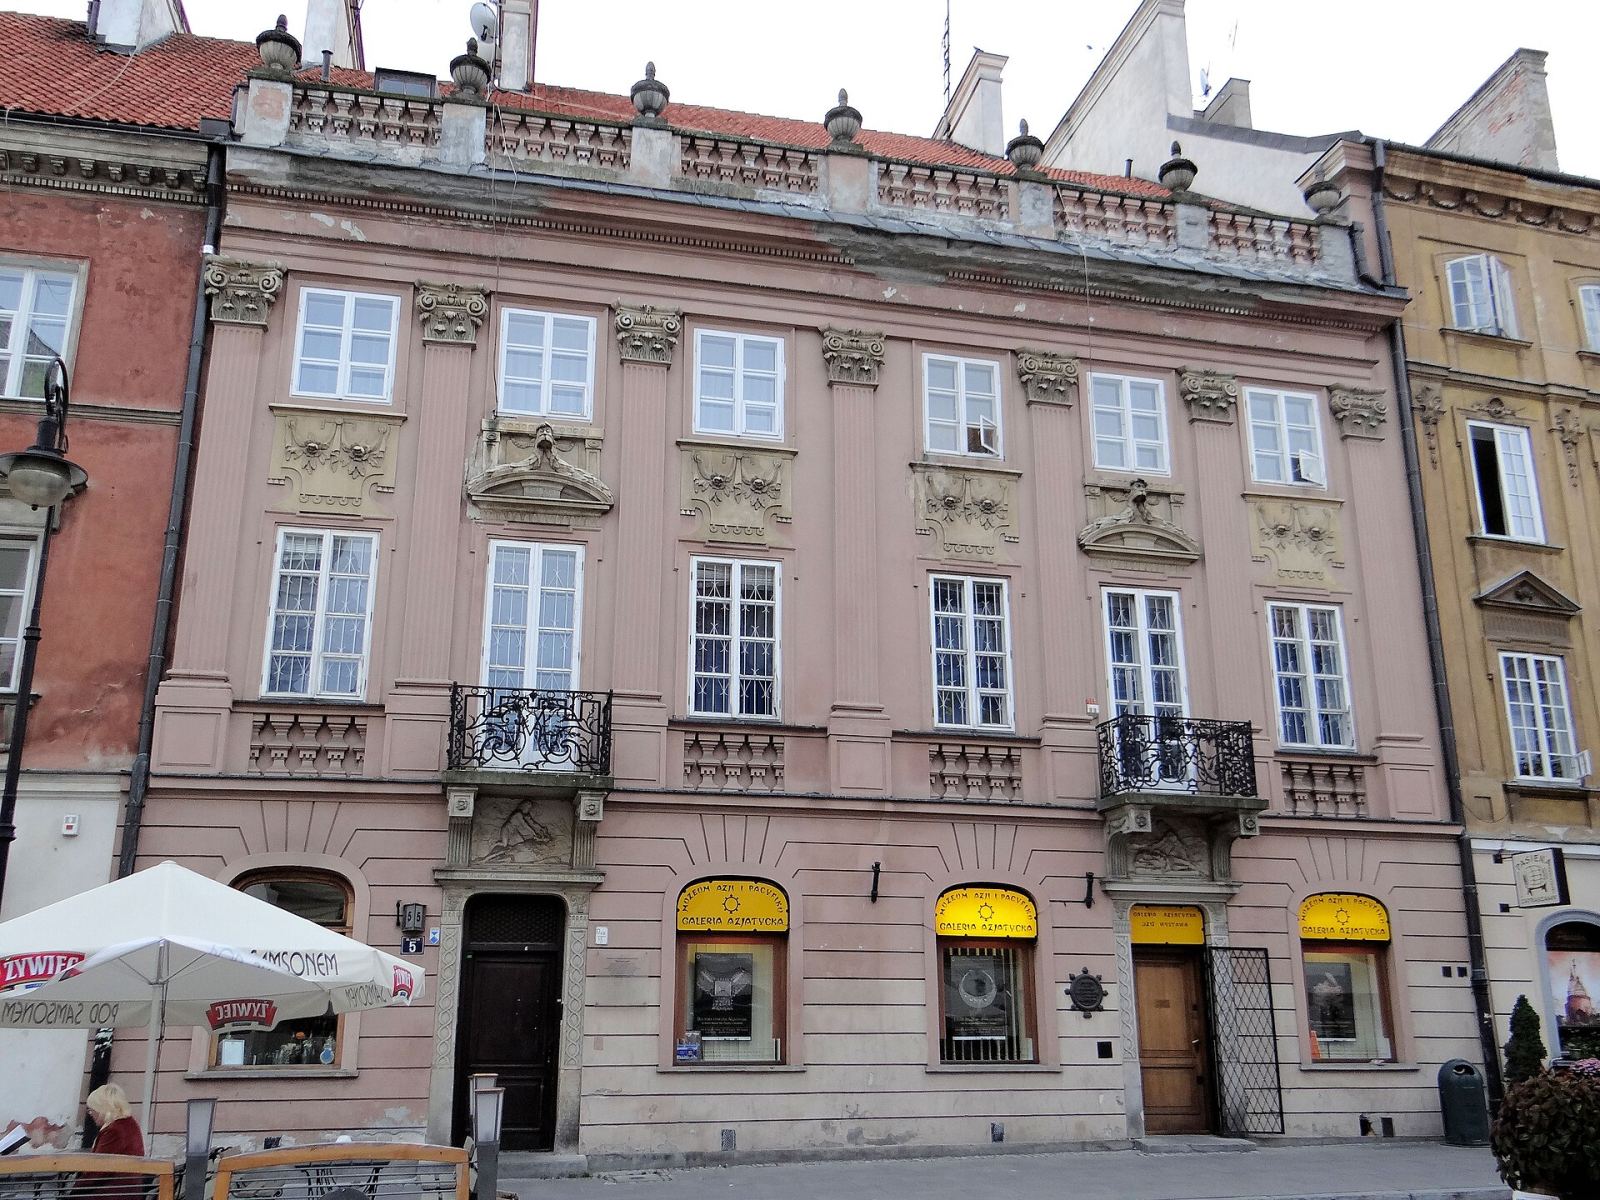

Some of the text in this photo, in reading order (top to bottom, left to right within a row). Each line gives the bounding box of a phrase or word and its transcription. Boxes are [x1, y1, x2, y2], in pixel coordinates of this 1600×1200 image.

[682, 886, 711, 912] MUZEUM
[682, 917, 784, 928] GALERIA AZJATYCKA
[939, 923, 1033, 933] GALERIA AZJATYCKA
[1302, 926, 1335, 934] GALERIA
[408, 941, 417, 953] 5
[251, 949, 339, 977] MSONEM
